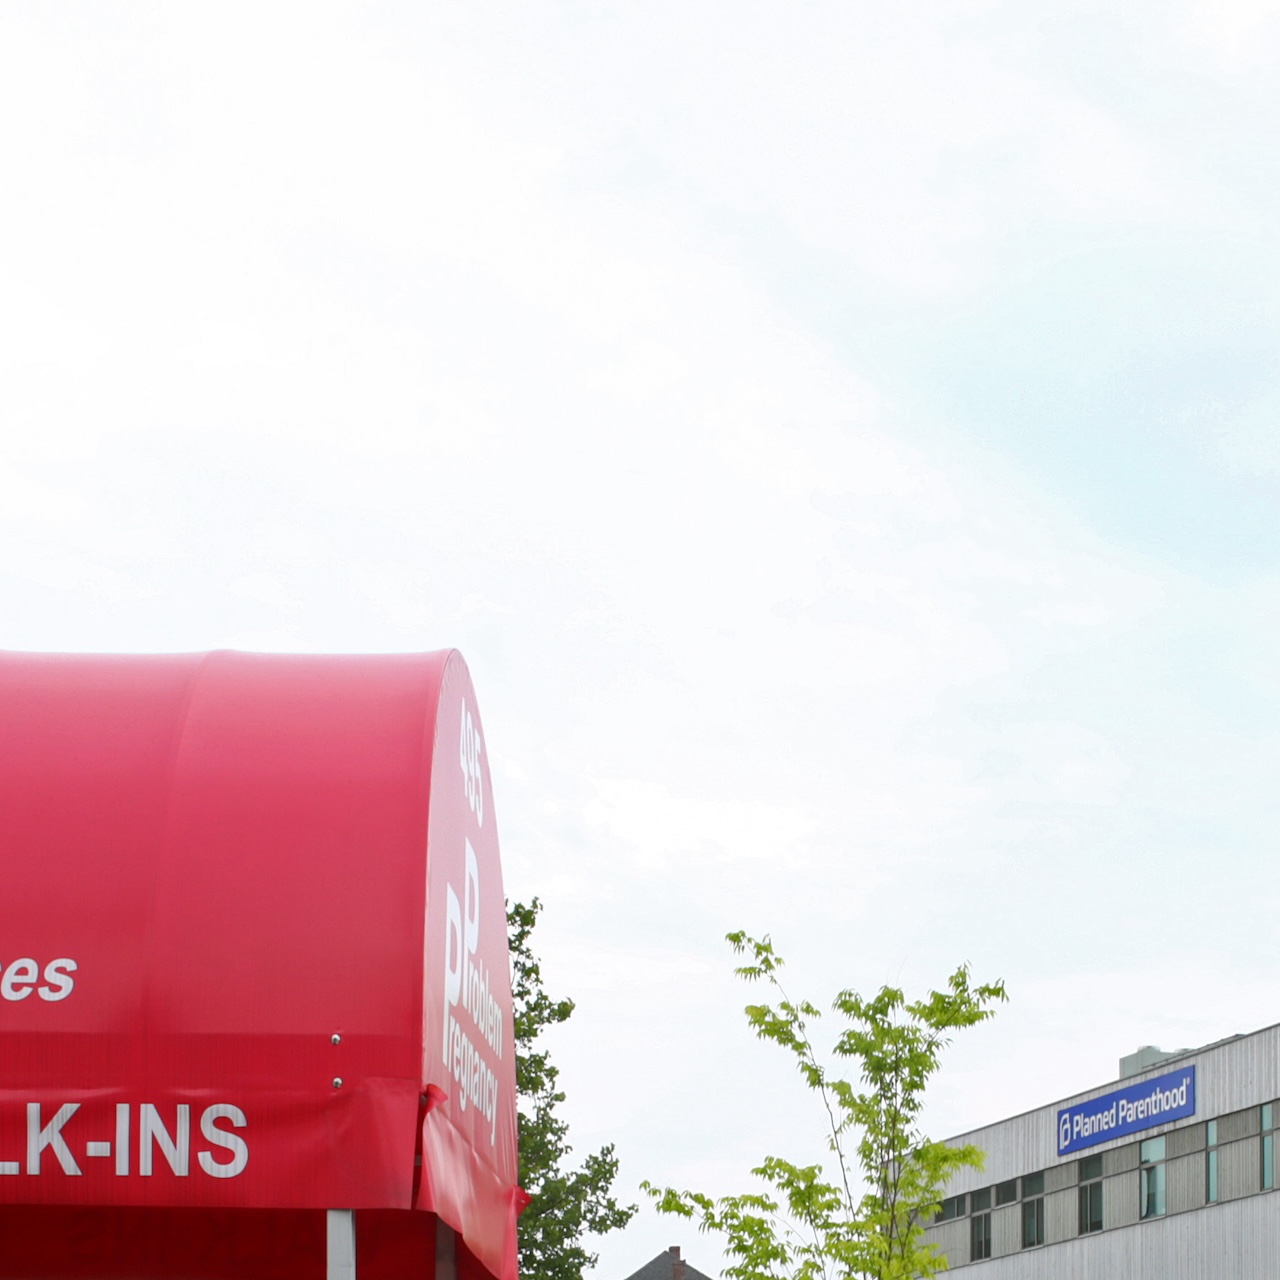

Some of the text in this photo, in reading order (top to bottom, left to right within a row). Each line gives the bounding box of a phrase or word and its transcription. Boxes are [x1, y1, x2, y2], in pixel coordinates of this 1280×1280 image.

[460, 695, 483, 829] 495
[442, 882, 498, 1147] Pregnancy
[463, 836, 503, 1061] Problem
[1073, 1101, 1117, 1141] Planned
